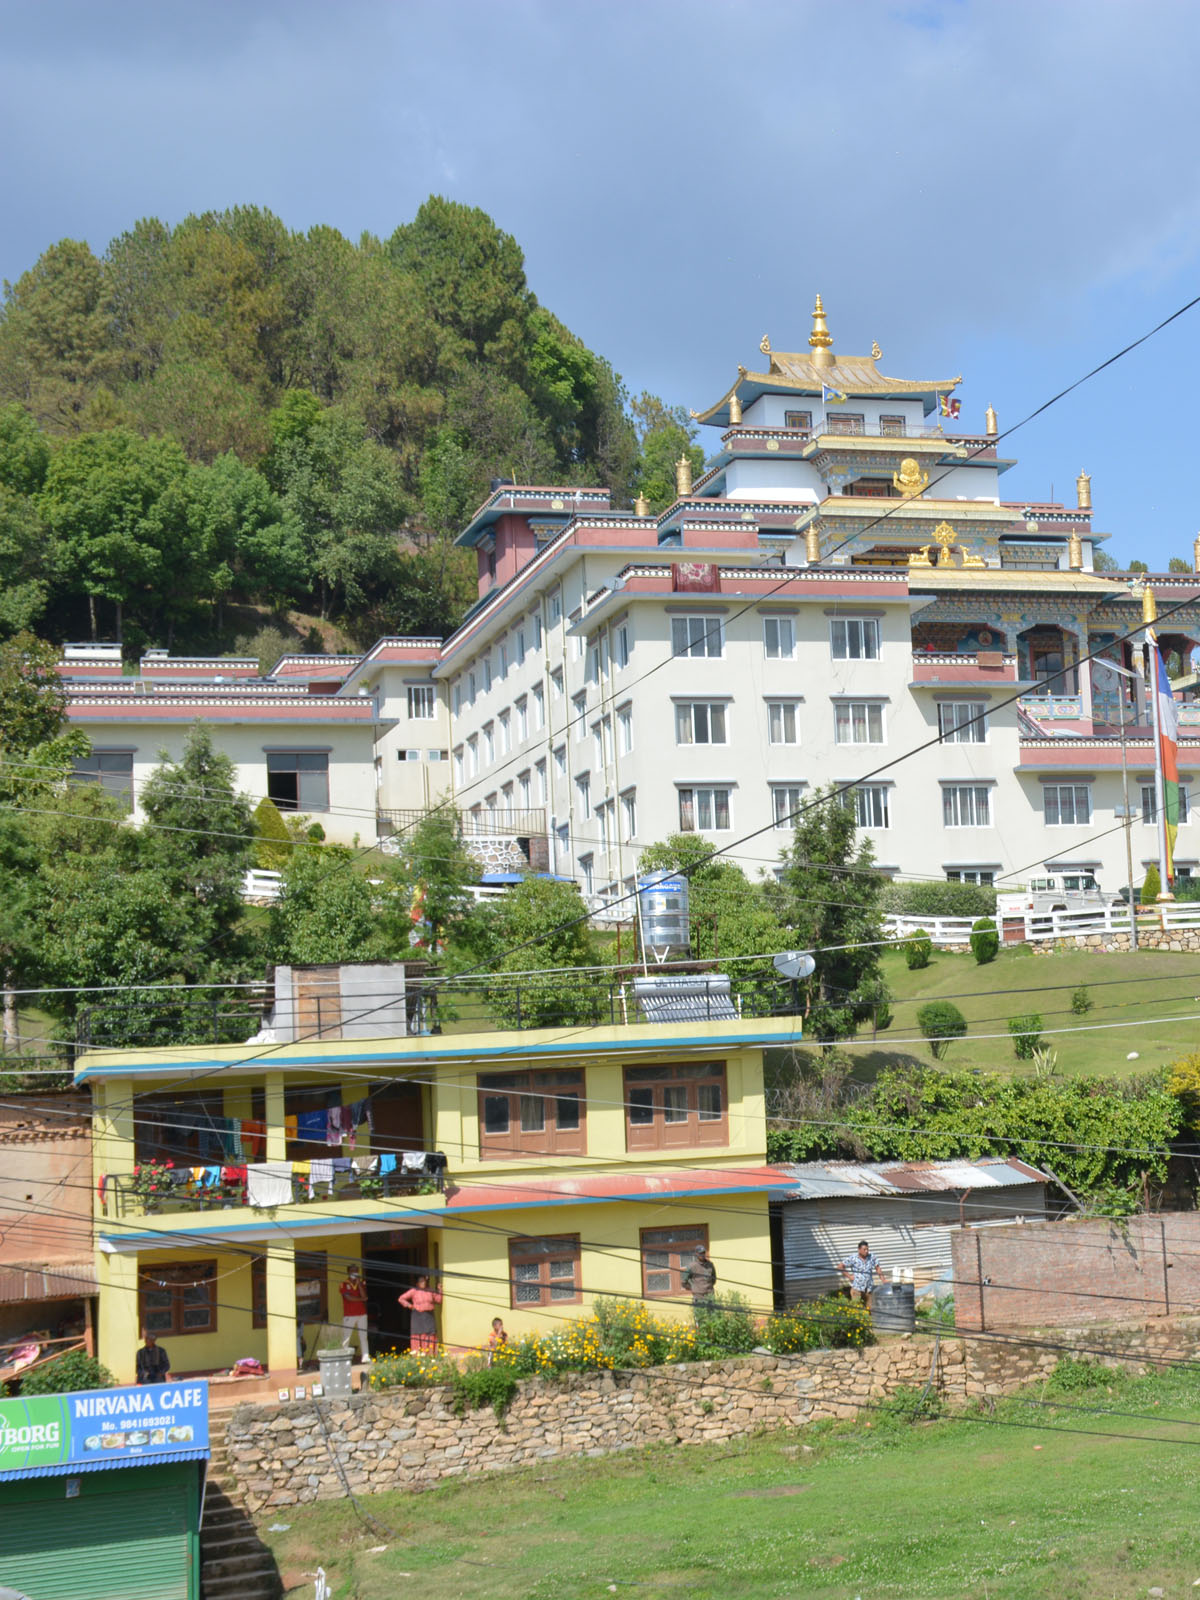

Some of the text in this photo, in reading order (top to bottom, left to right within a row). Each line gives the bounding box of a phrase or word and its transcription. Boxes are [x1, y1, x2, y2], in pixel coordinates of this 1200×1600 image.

[74, 1388, 202, 1418] NIRVANA CAFE
[101, 1415, 176, 1432] Mo. 9841693021
